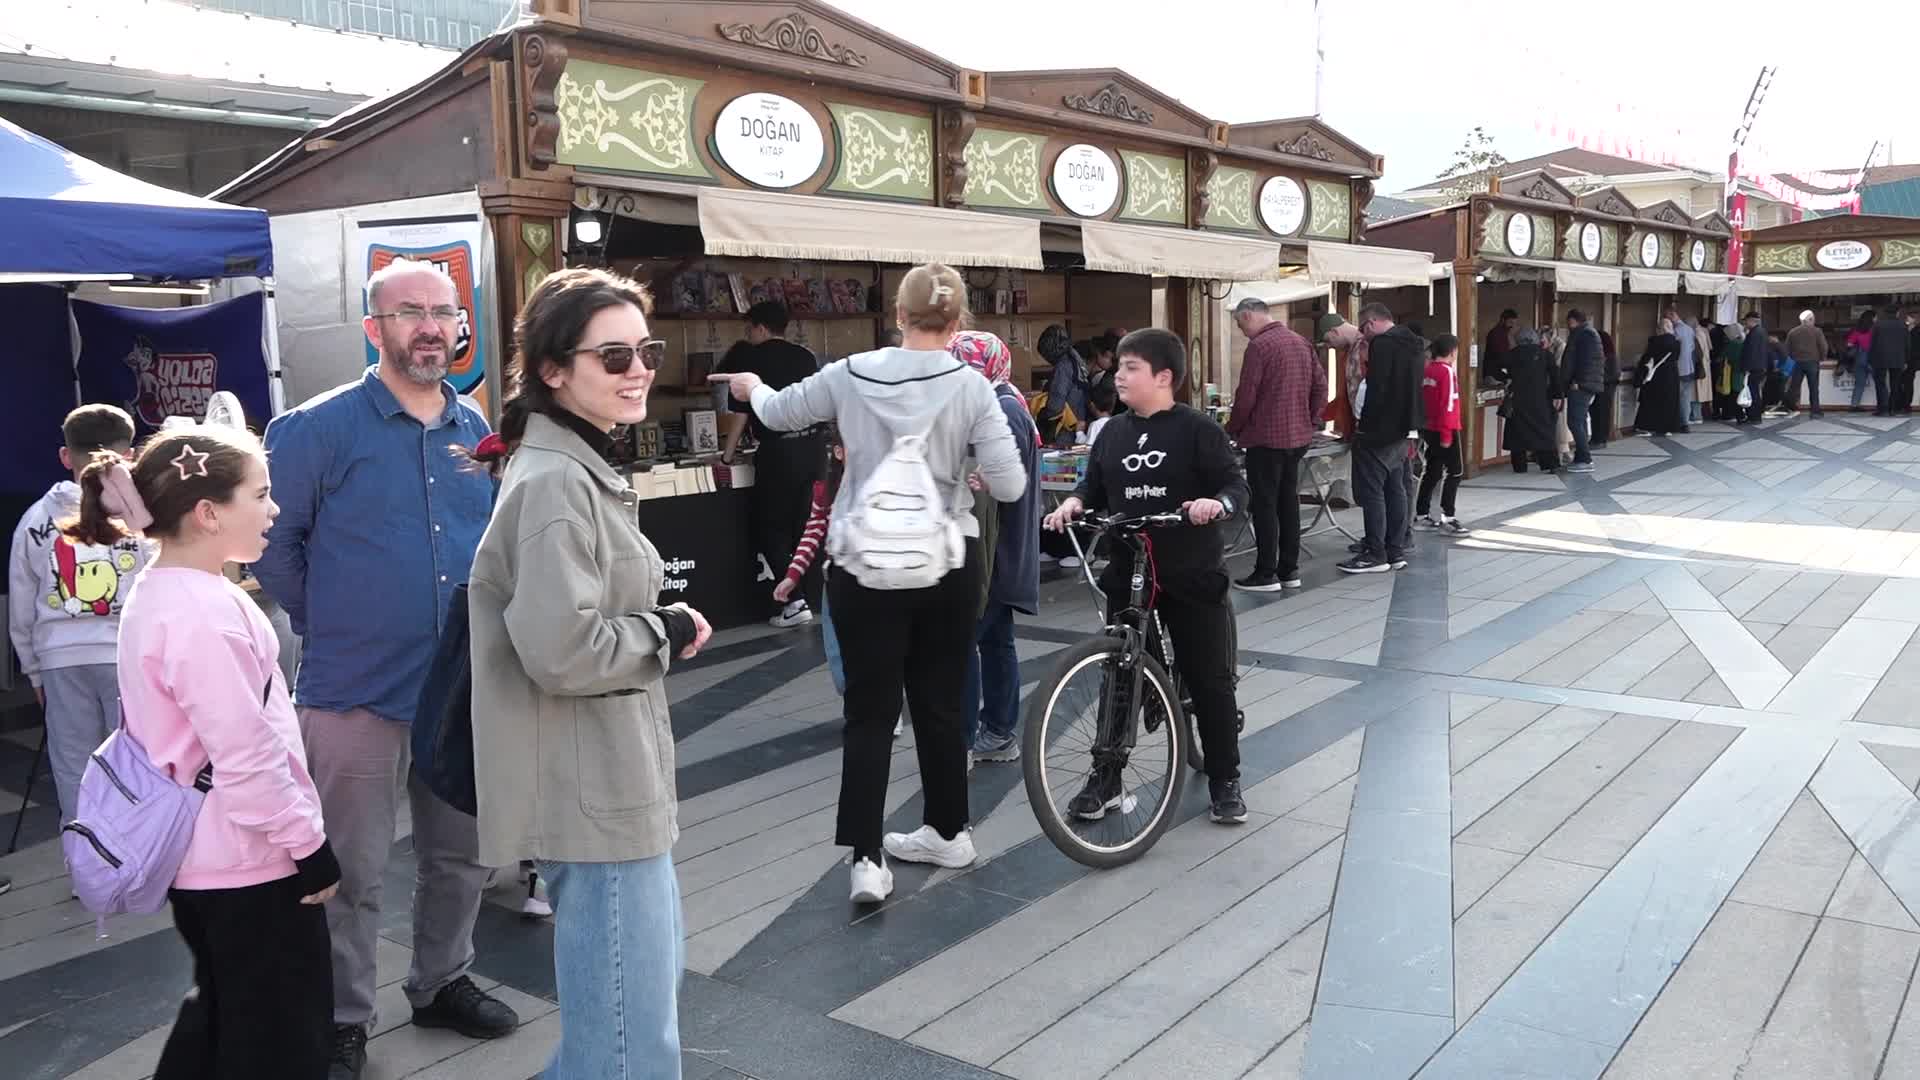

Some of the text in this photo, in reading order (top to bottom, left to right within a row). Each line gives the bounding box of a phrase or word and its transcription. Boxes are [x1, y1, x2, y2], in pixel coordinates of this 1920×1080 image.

[740, 115, 800, 142] DOĞAN
[1068, 161, 1104, 181] DOĞAN
[663, 557, 695, 574] oğan
